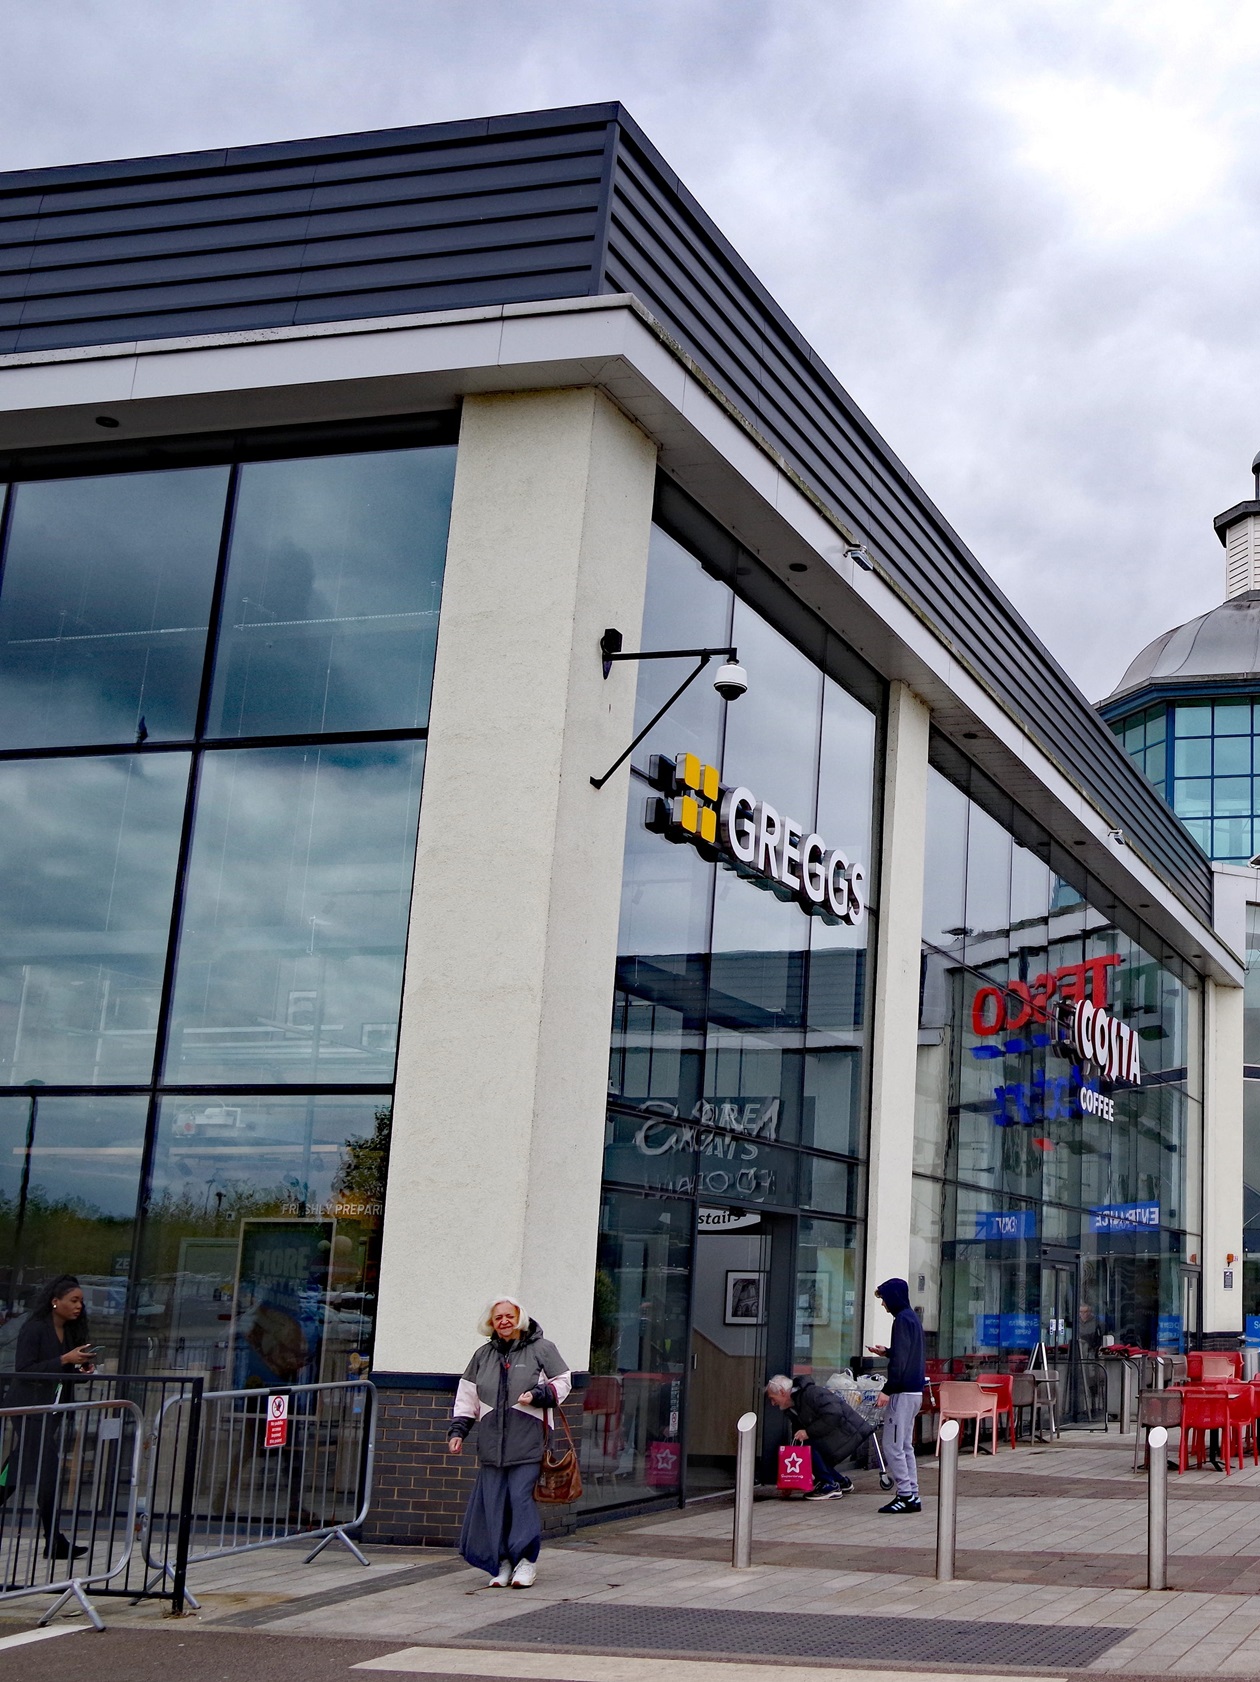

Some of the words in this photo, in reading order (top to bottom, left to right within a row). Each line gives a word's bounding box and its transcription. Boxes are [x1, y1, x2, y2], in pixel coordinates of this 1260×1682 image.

[720, 786, 866, 926] GREGGS
[1075, 999, 1141, 1085] COSTA
[1080, 1086, 1115, 1122] COFFEE
[254, 1246, 311, 1278] MORE
